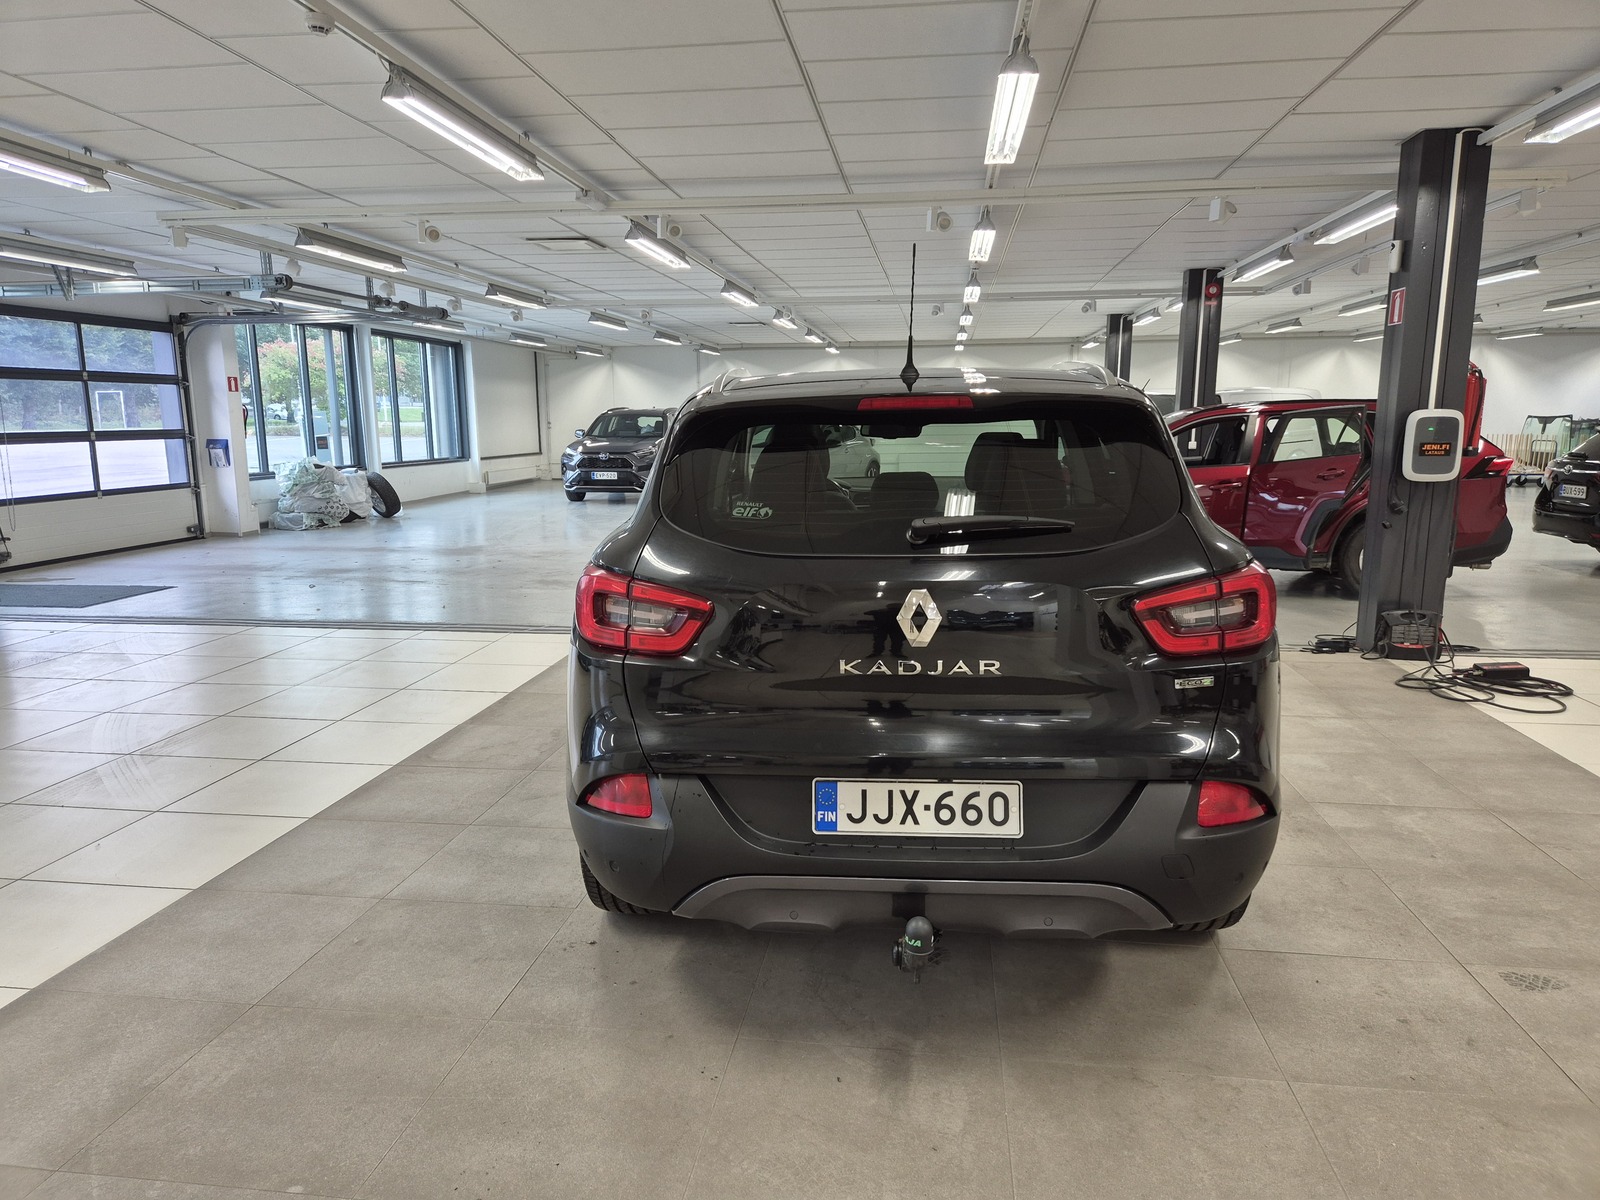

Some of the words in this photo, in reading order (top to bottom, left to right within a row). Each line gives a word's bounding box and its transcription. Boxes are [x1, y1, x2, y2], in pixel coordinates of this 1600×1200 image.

[839, 659, 1002, 676] KADJAR
[846, 788, 1010, 827] JJX-660
[817, 811, 836, 823] FIN
